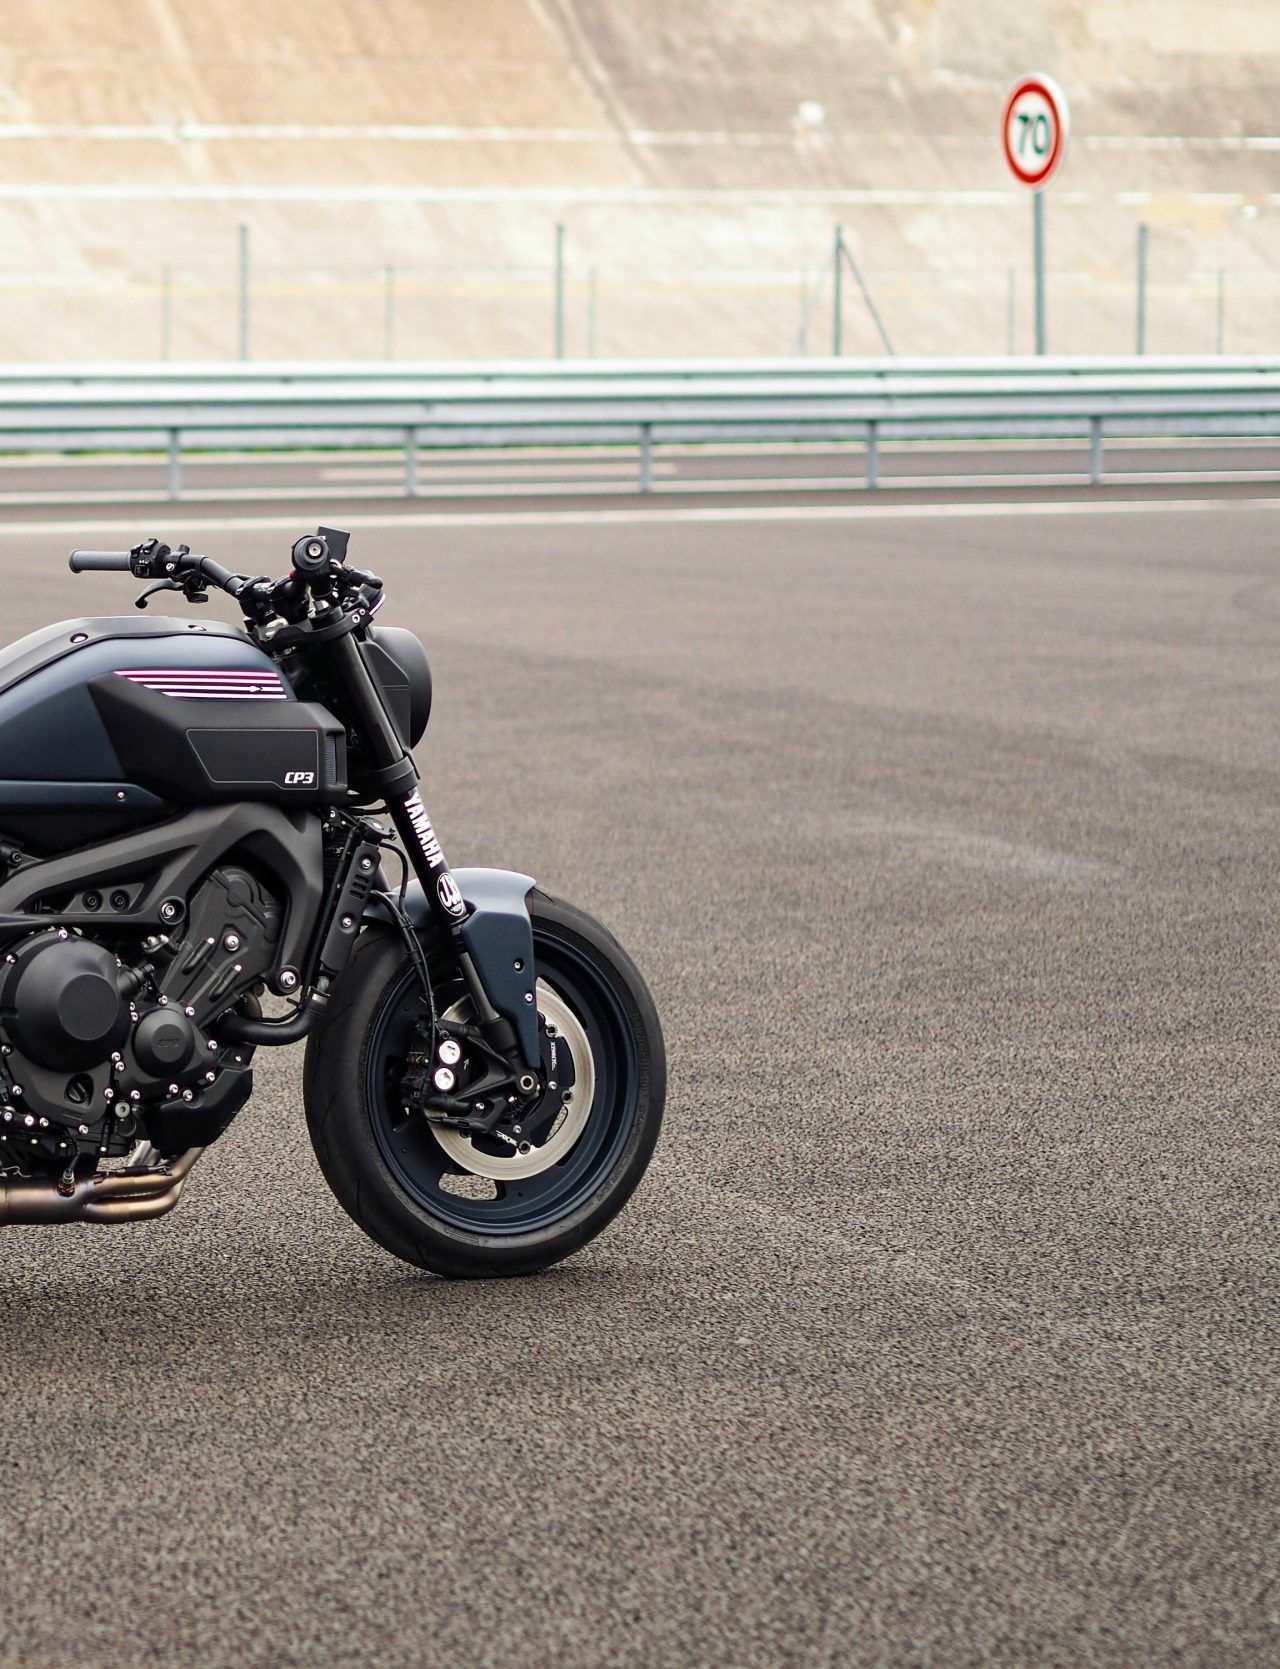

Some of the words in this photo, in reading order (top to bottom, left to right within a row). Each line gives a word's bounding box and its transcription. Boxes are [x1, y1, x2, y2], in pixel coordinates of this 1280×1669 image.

[1017, 114, 1049, 156] 70
[284, 771, 315, 784] CP3
[404, 789, 445, 868] YAMAHA
